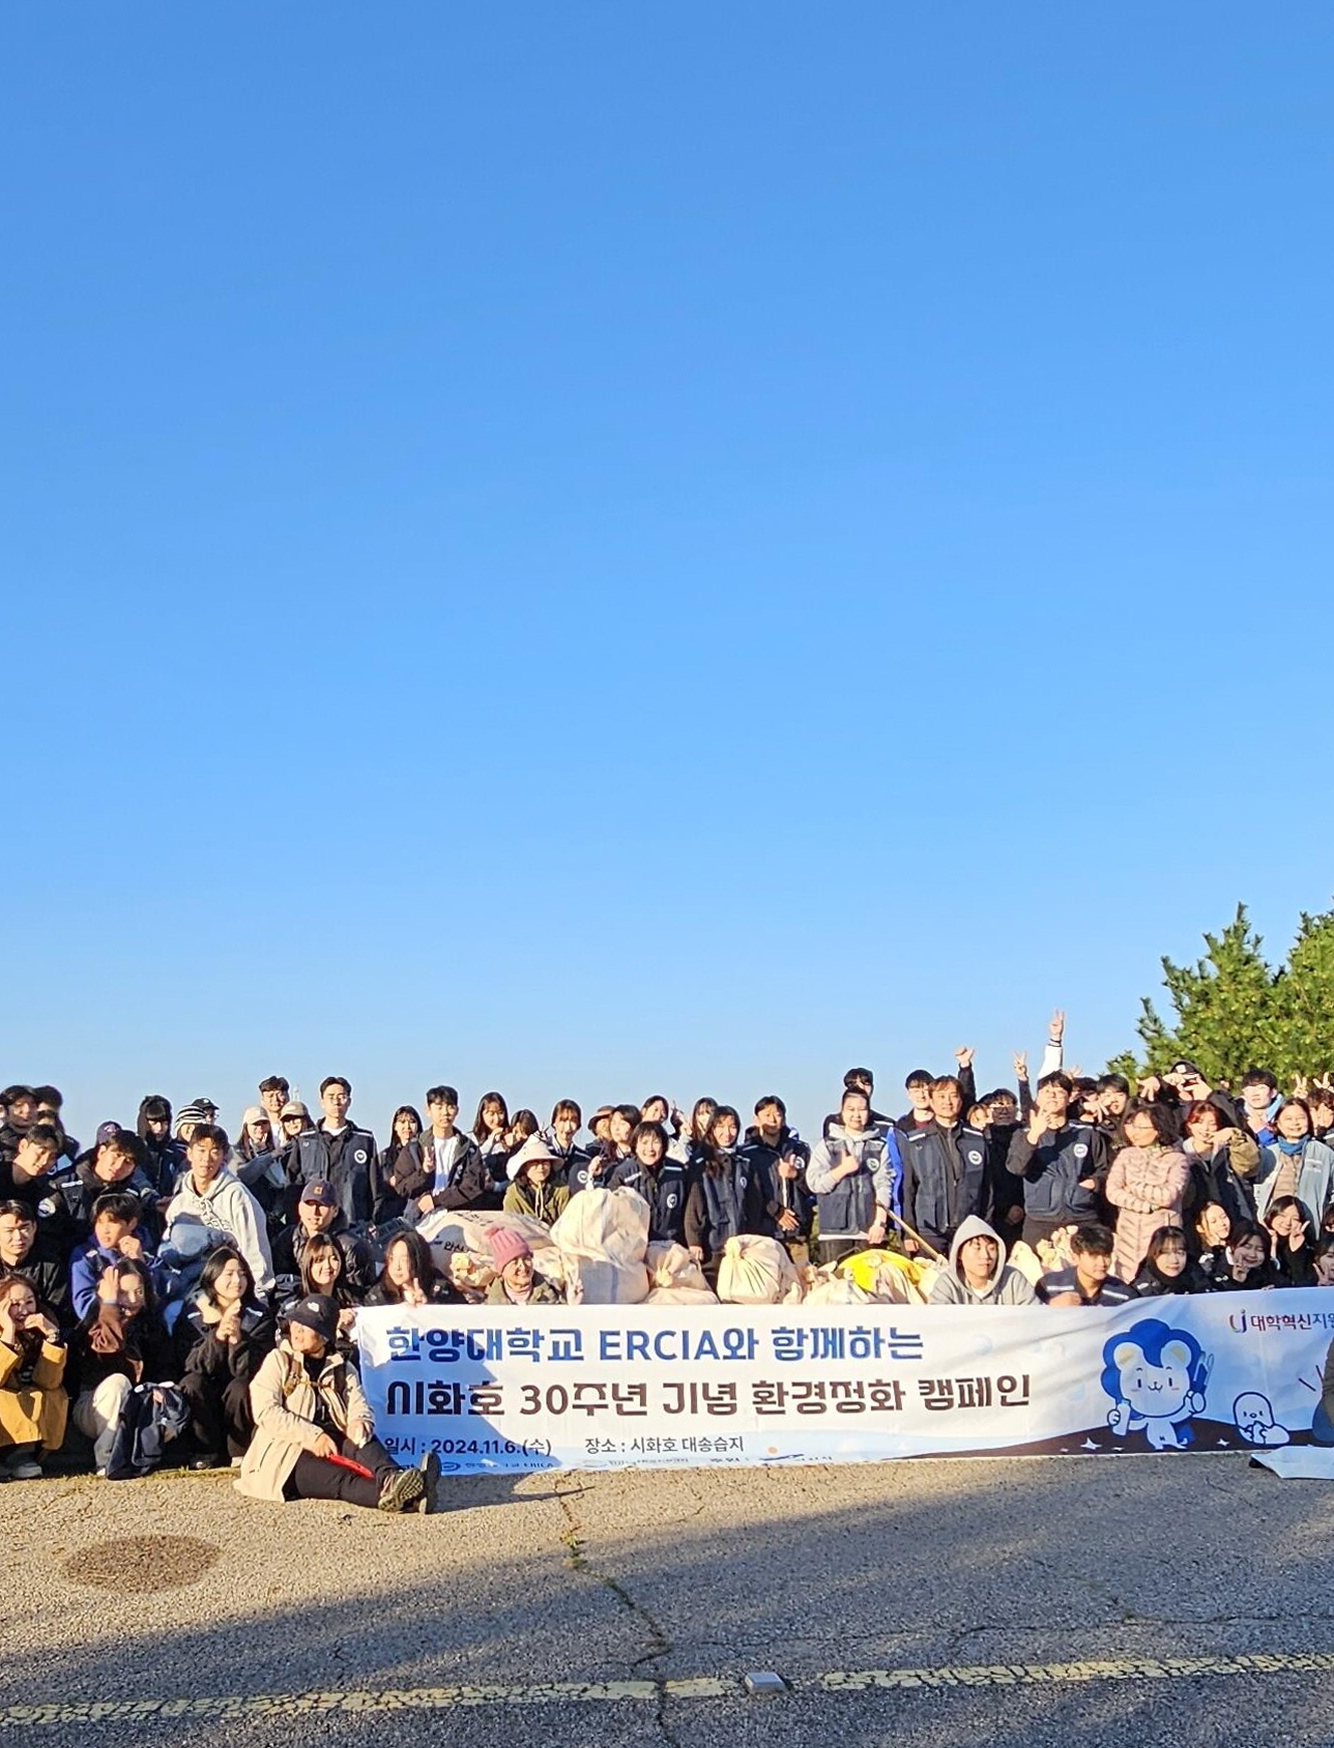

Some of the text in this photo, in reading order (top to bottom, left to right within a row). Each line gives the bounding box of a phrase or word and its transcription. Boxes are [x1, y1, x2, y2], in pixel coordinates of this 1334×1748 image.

[386, 1325, 924, 1363] 한양대학교 ERCIA와 함께하는
[387, 1374, 1031, 1417] 시화호 30주년 기념 환경정화 캠페인
[384, 1437, 417, 1455] 일시
[431, 1437, 552, 1456] 2024.11.6.(수)
[584, 1438, 617, 1454] 장소
[630, 1437, 678, 1453] 시화호
[681, 1436, 744, 1453] 대송습지
